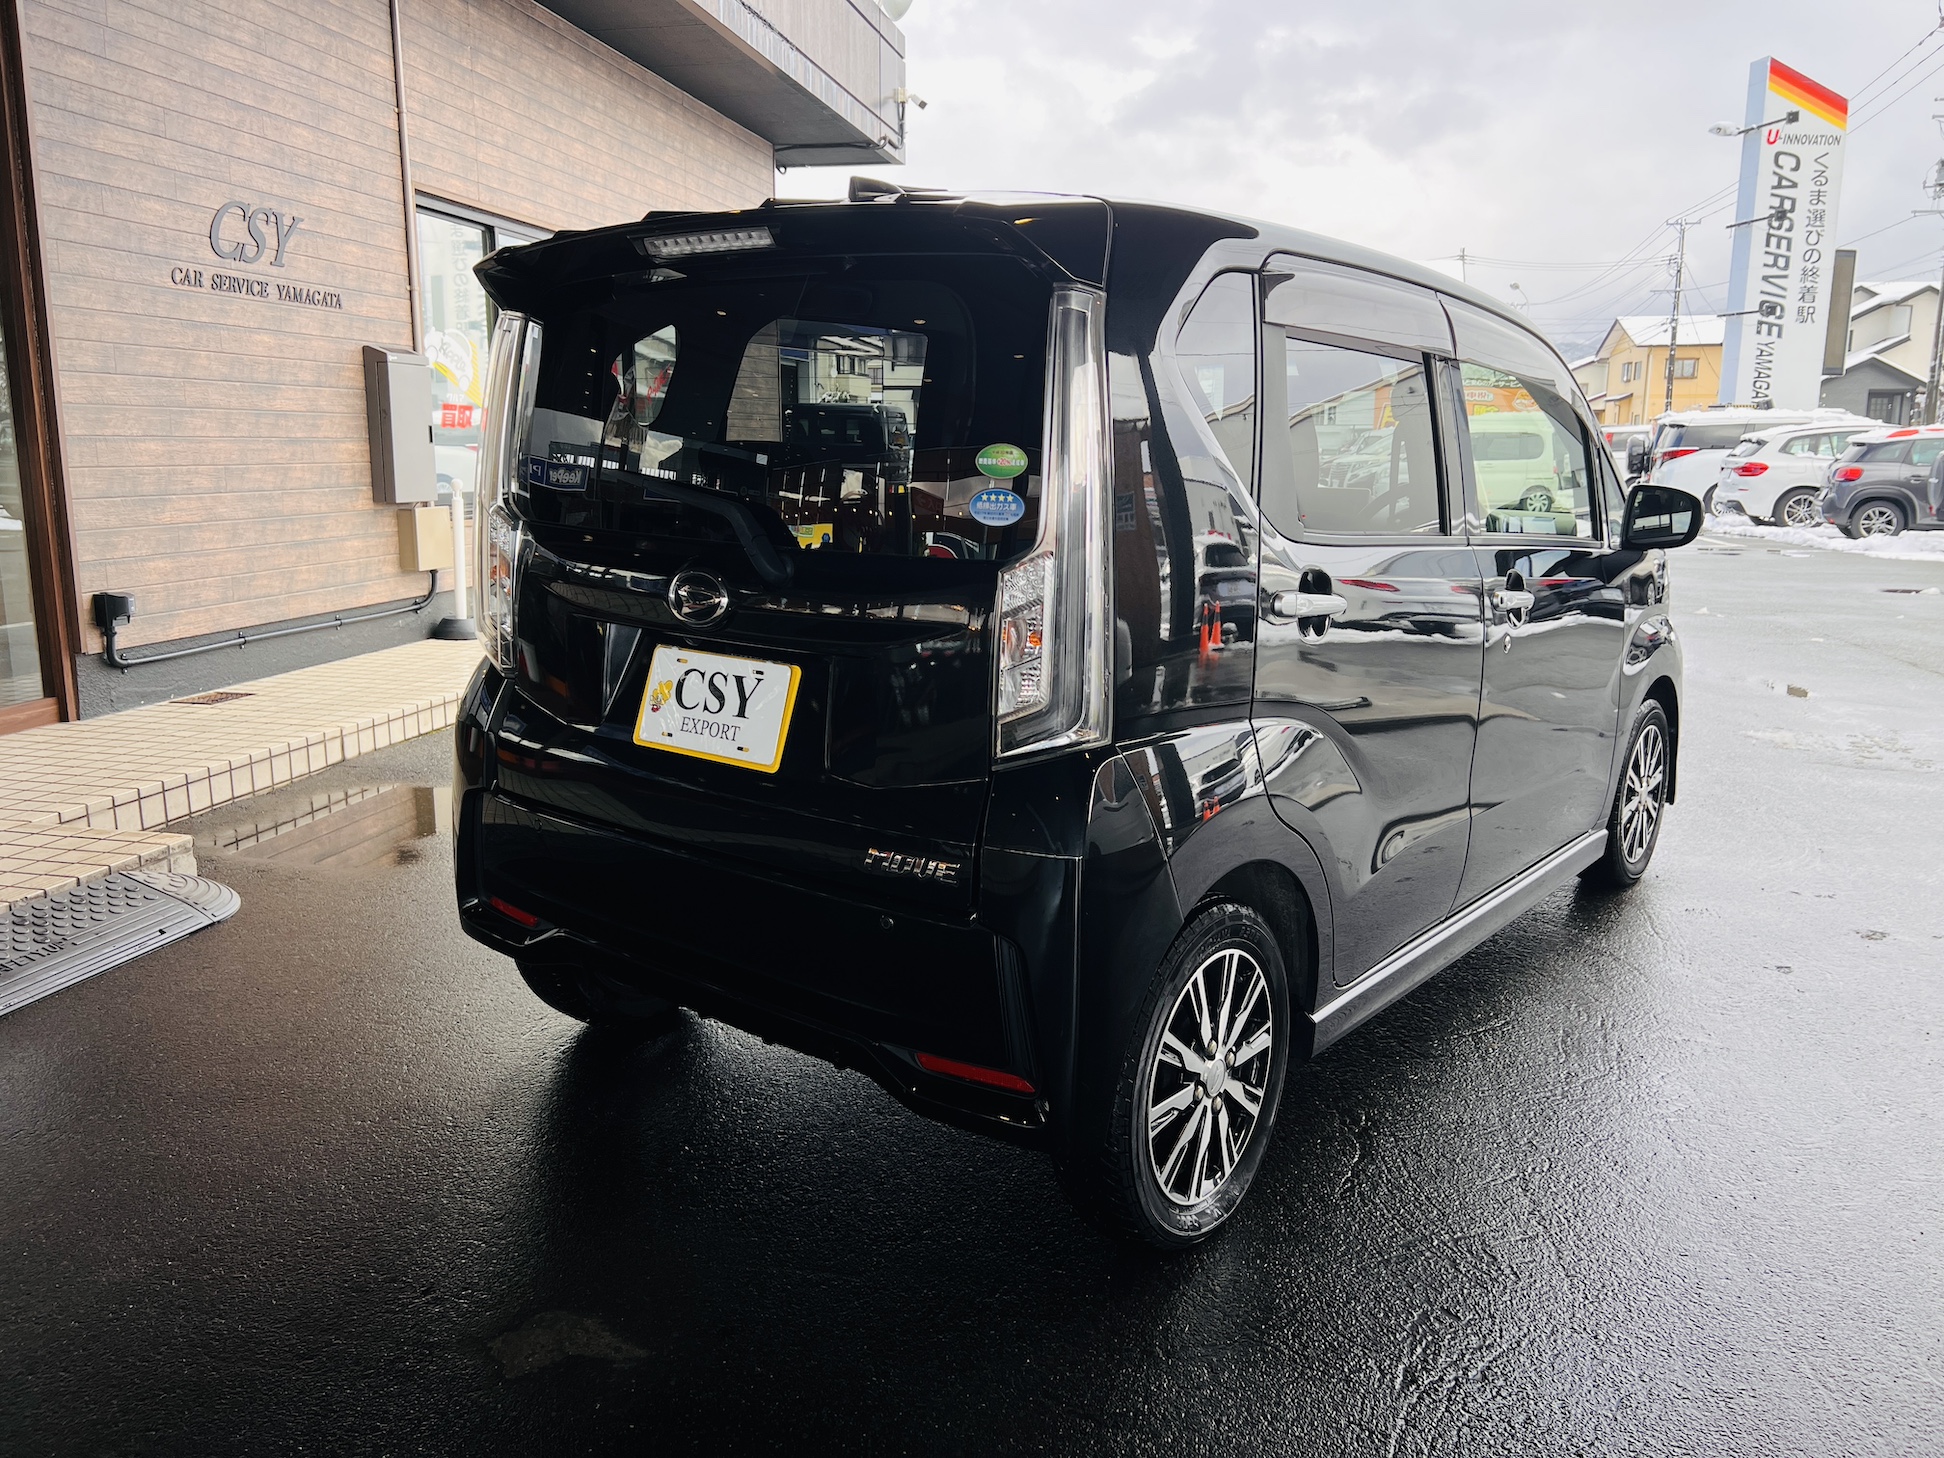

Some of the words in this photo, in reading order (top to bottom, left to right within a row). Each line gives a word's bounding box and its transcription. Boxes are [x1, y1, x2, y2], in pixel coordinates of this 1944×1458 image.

[1767, 129, 1841, 146] U-INNOVATION
[210, 201, 304, 268] CSY
[1795, 151, 1829, 324] くるま選びの終着駅
[171, 266, 205, 288] CAR
[211, 273, 270, 298] SERVICE
[276, 284, 343, 309] YAMAGATA
[1751, 341, 1775, 404] YAMAGA
[675, 668, 764, 719] CSY
[680, 716, 741, 742] EXPORT
